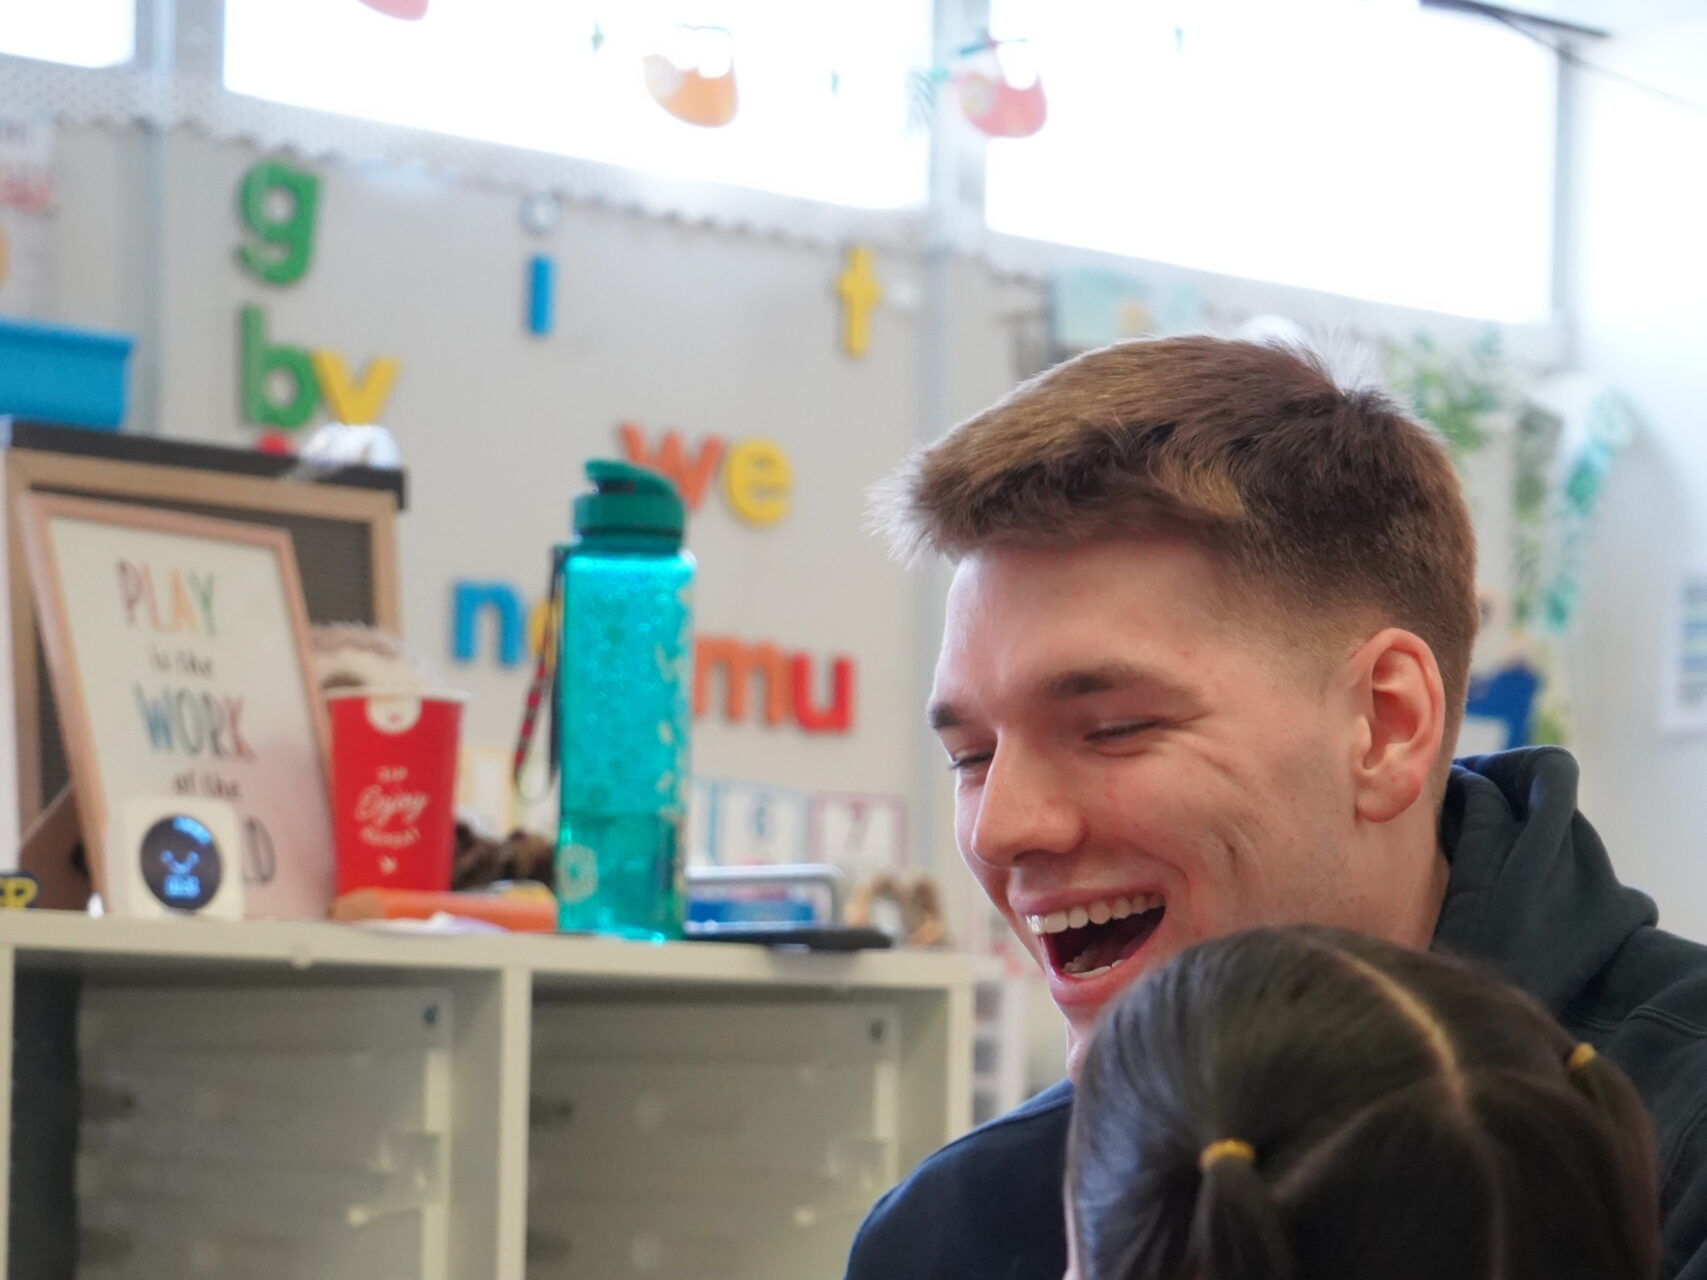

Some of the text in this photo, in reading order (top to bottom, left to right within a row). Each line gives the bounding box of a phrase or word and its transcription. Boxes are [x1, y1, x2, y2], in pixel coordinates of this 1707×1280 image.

[237, 158, 321, 286] g
[832, 246, 882, 359] t
[116, 559, 218, 637] PLAY
[130, 682, 258, 764] WORK
